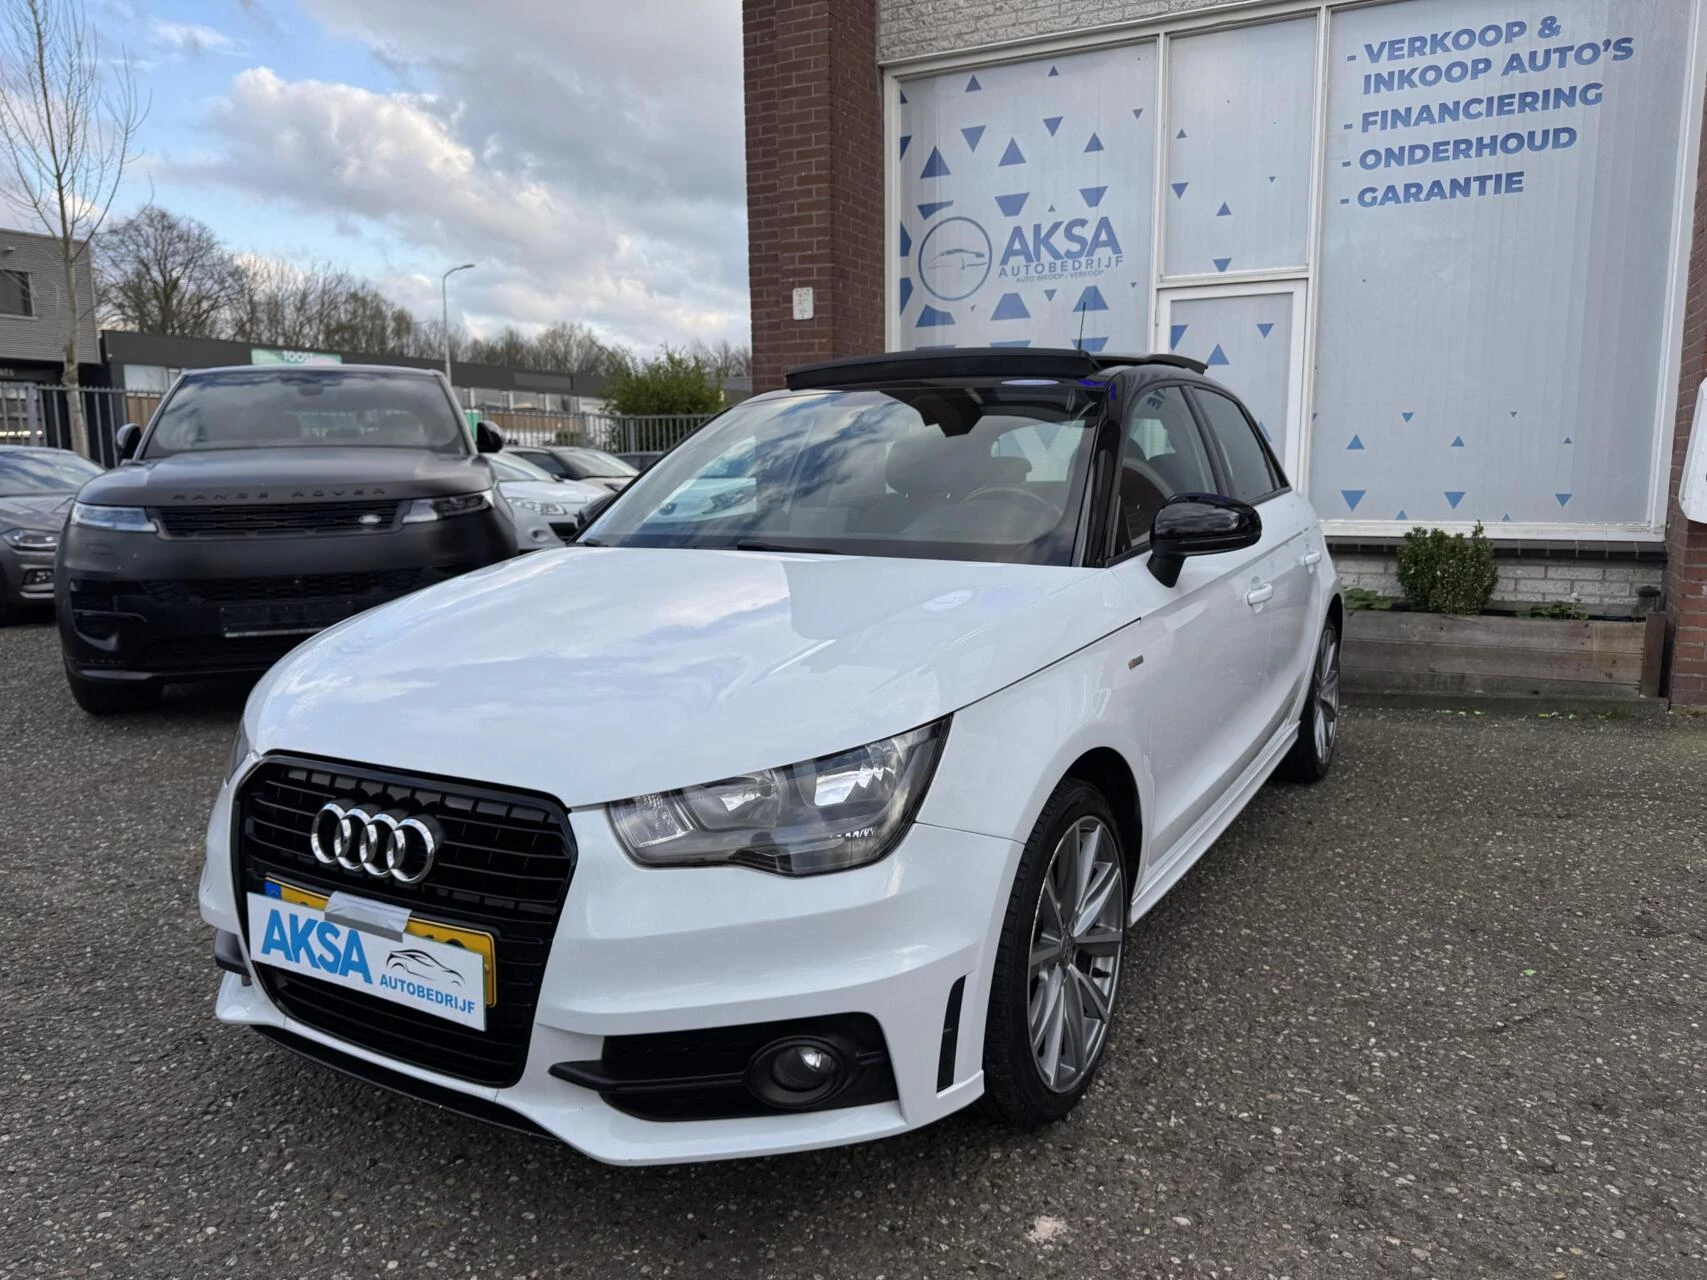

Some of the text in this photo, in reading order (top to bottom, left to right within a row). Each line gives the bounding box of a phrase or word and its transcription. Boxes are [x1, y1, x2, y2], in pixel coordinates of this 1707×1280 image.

[1364, 20, 1527, 64] VERKOOP
[1537, 15, 1562, 39] &
[1363, 37, 1634, 95] INKOOP AUTO'S
[1361, 82, 1604, 133] FINANCIERING
[1359, 126, 1577, 171] ONDERHOUD
[1357, 171, 1525, 208] GARANTIE
[1000, 216, 1122, 266] AKSA
[998, 255, 1124, 278] AUTOBEDRIJF
[1016, 275, 1035, 283] AUTO
[1070, 269, 1104, 279] VERKOOP
[260, 908, 373, 985] AKSA
[379, 973, 476, 1015] AUTOBEDRIJF
